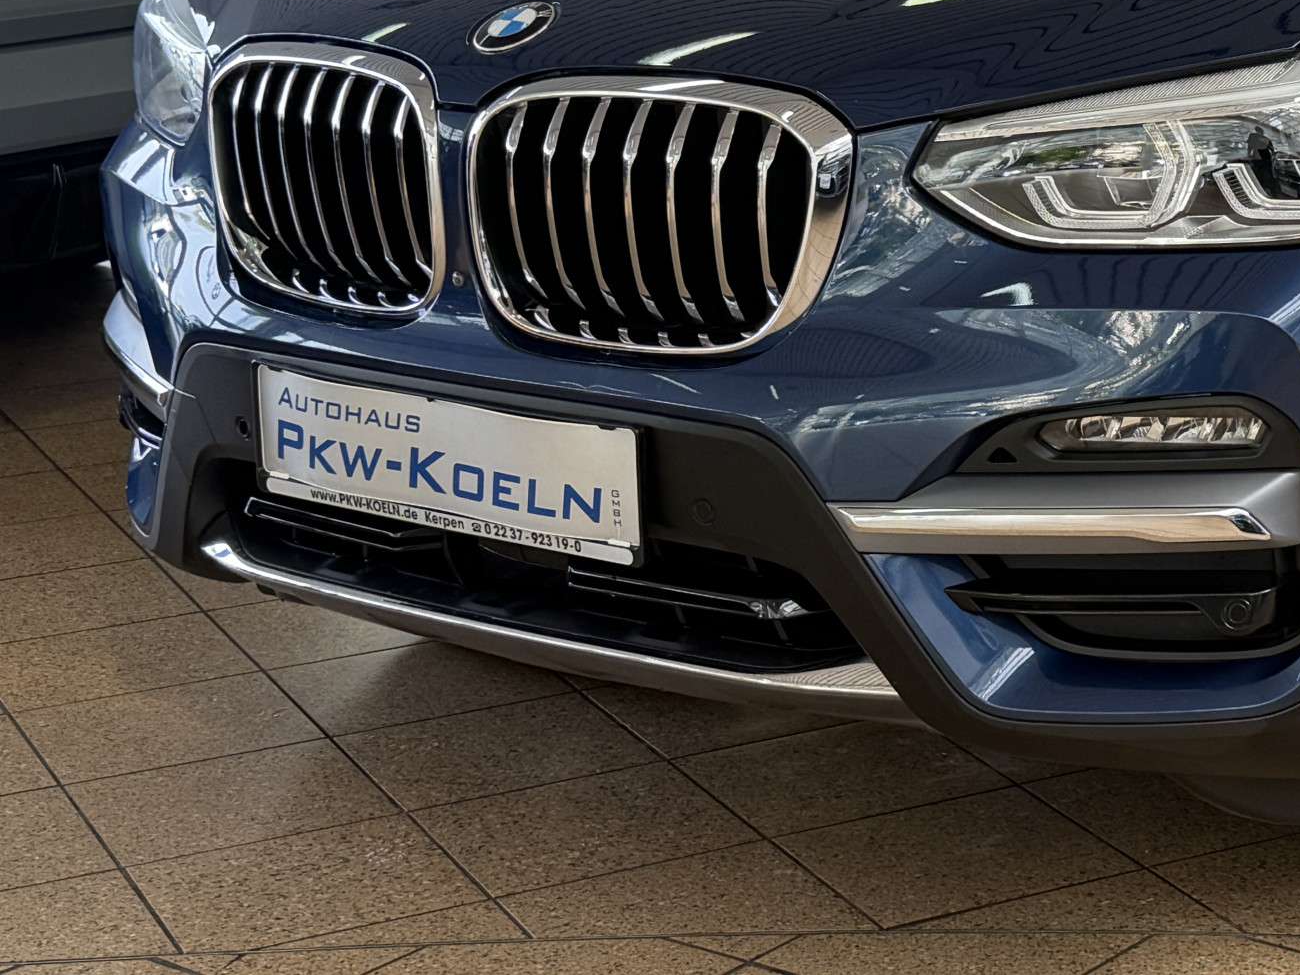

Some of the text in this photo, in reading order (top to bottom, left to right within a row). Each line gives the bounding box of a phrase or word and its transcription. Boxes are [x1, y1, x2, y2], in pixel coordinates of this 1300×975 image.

[278, 387, 421, 433] AUTOHAUS
[277, 419, 602, 524] PKW-KOELN
[310, 489, 418, 520] www.PKW-KOELN.de
[424, 510, 465, 530] Kerpen
